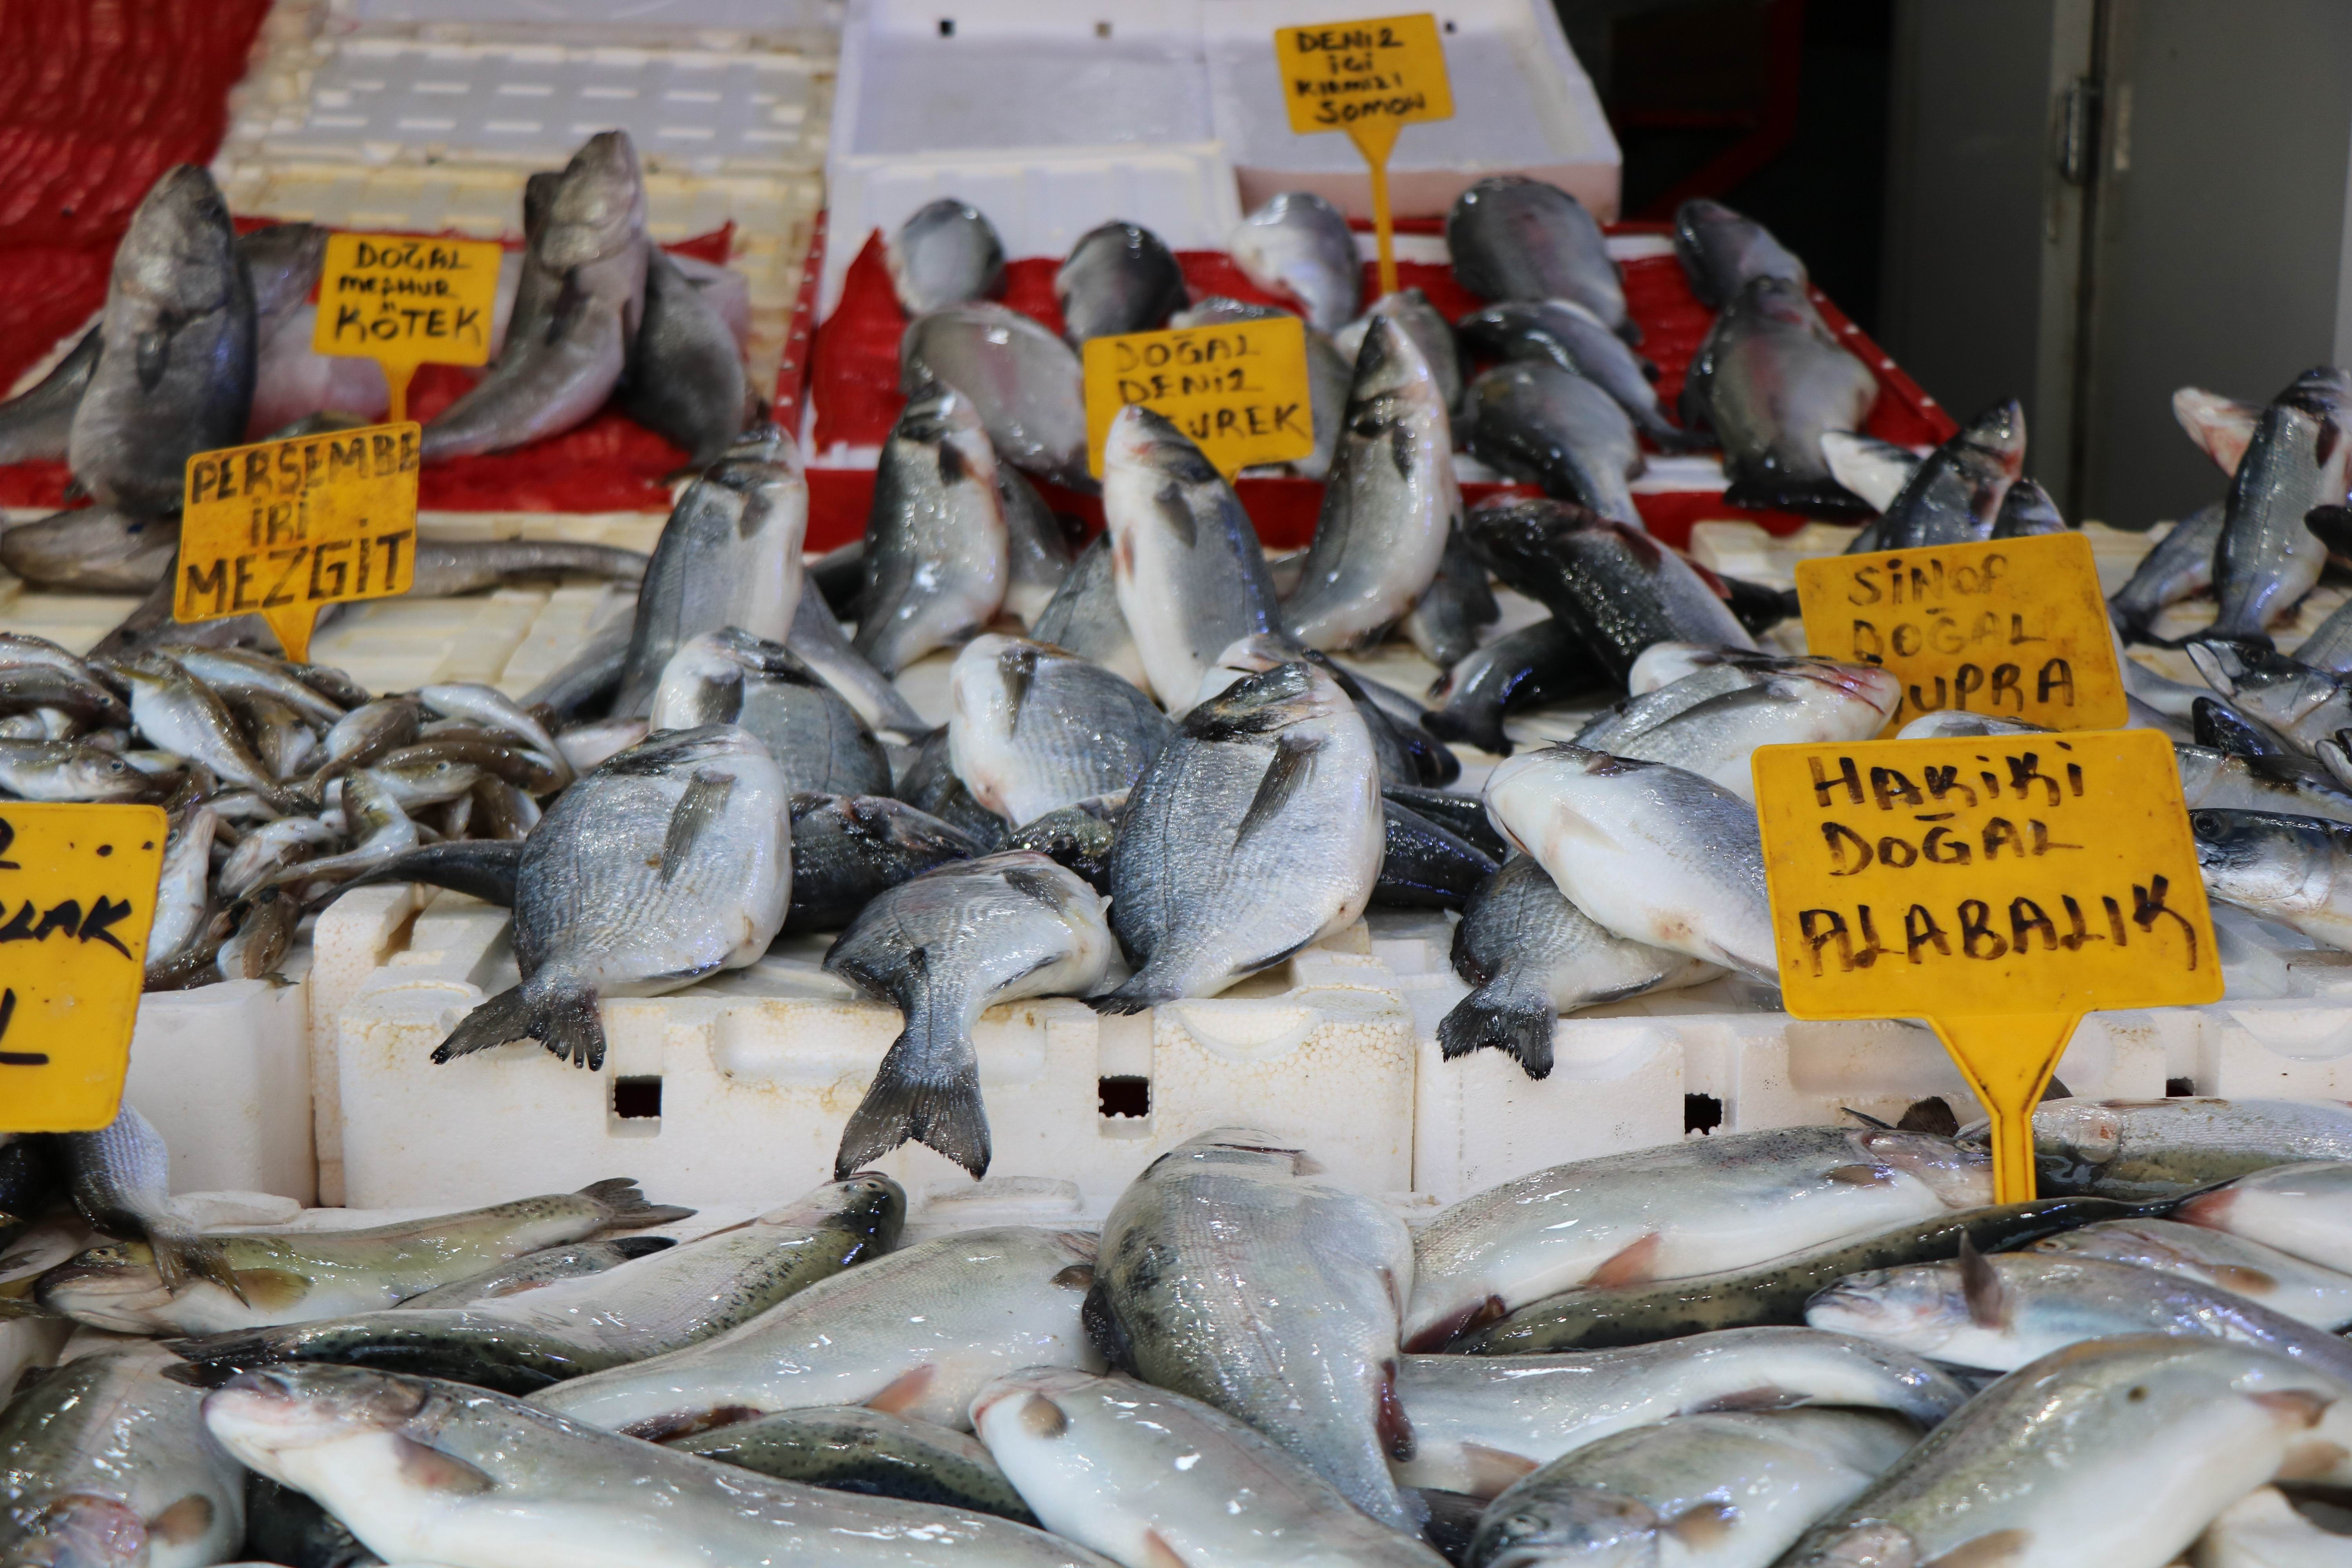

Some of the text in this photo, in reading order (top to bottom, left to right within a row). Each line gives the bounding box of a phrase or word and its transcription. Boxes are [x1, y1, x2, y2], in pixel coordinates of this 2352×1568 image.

[334, 302, 482, 347] KÖTEK
[185, 518, 412, 614] MEZGİT
[1889, 658, 2075, 724] UPRA
[1820, 812, 2084, 876] DOĞAL
[1798, 874, 2197, 978] ALABALIK
